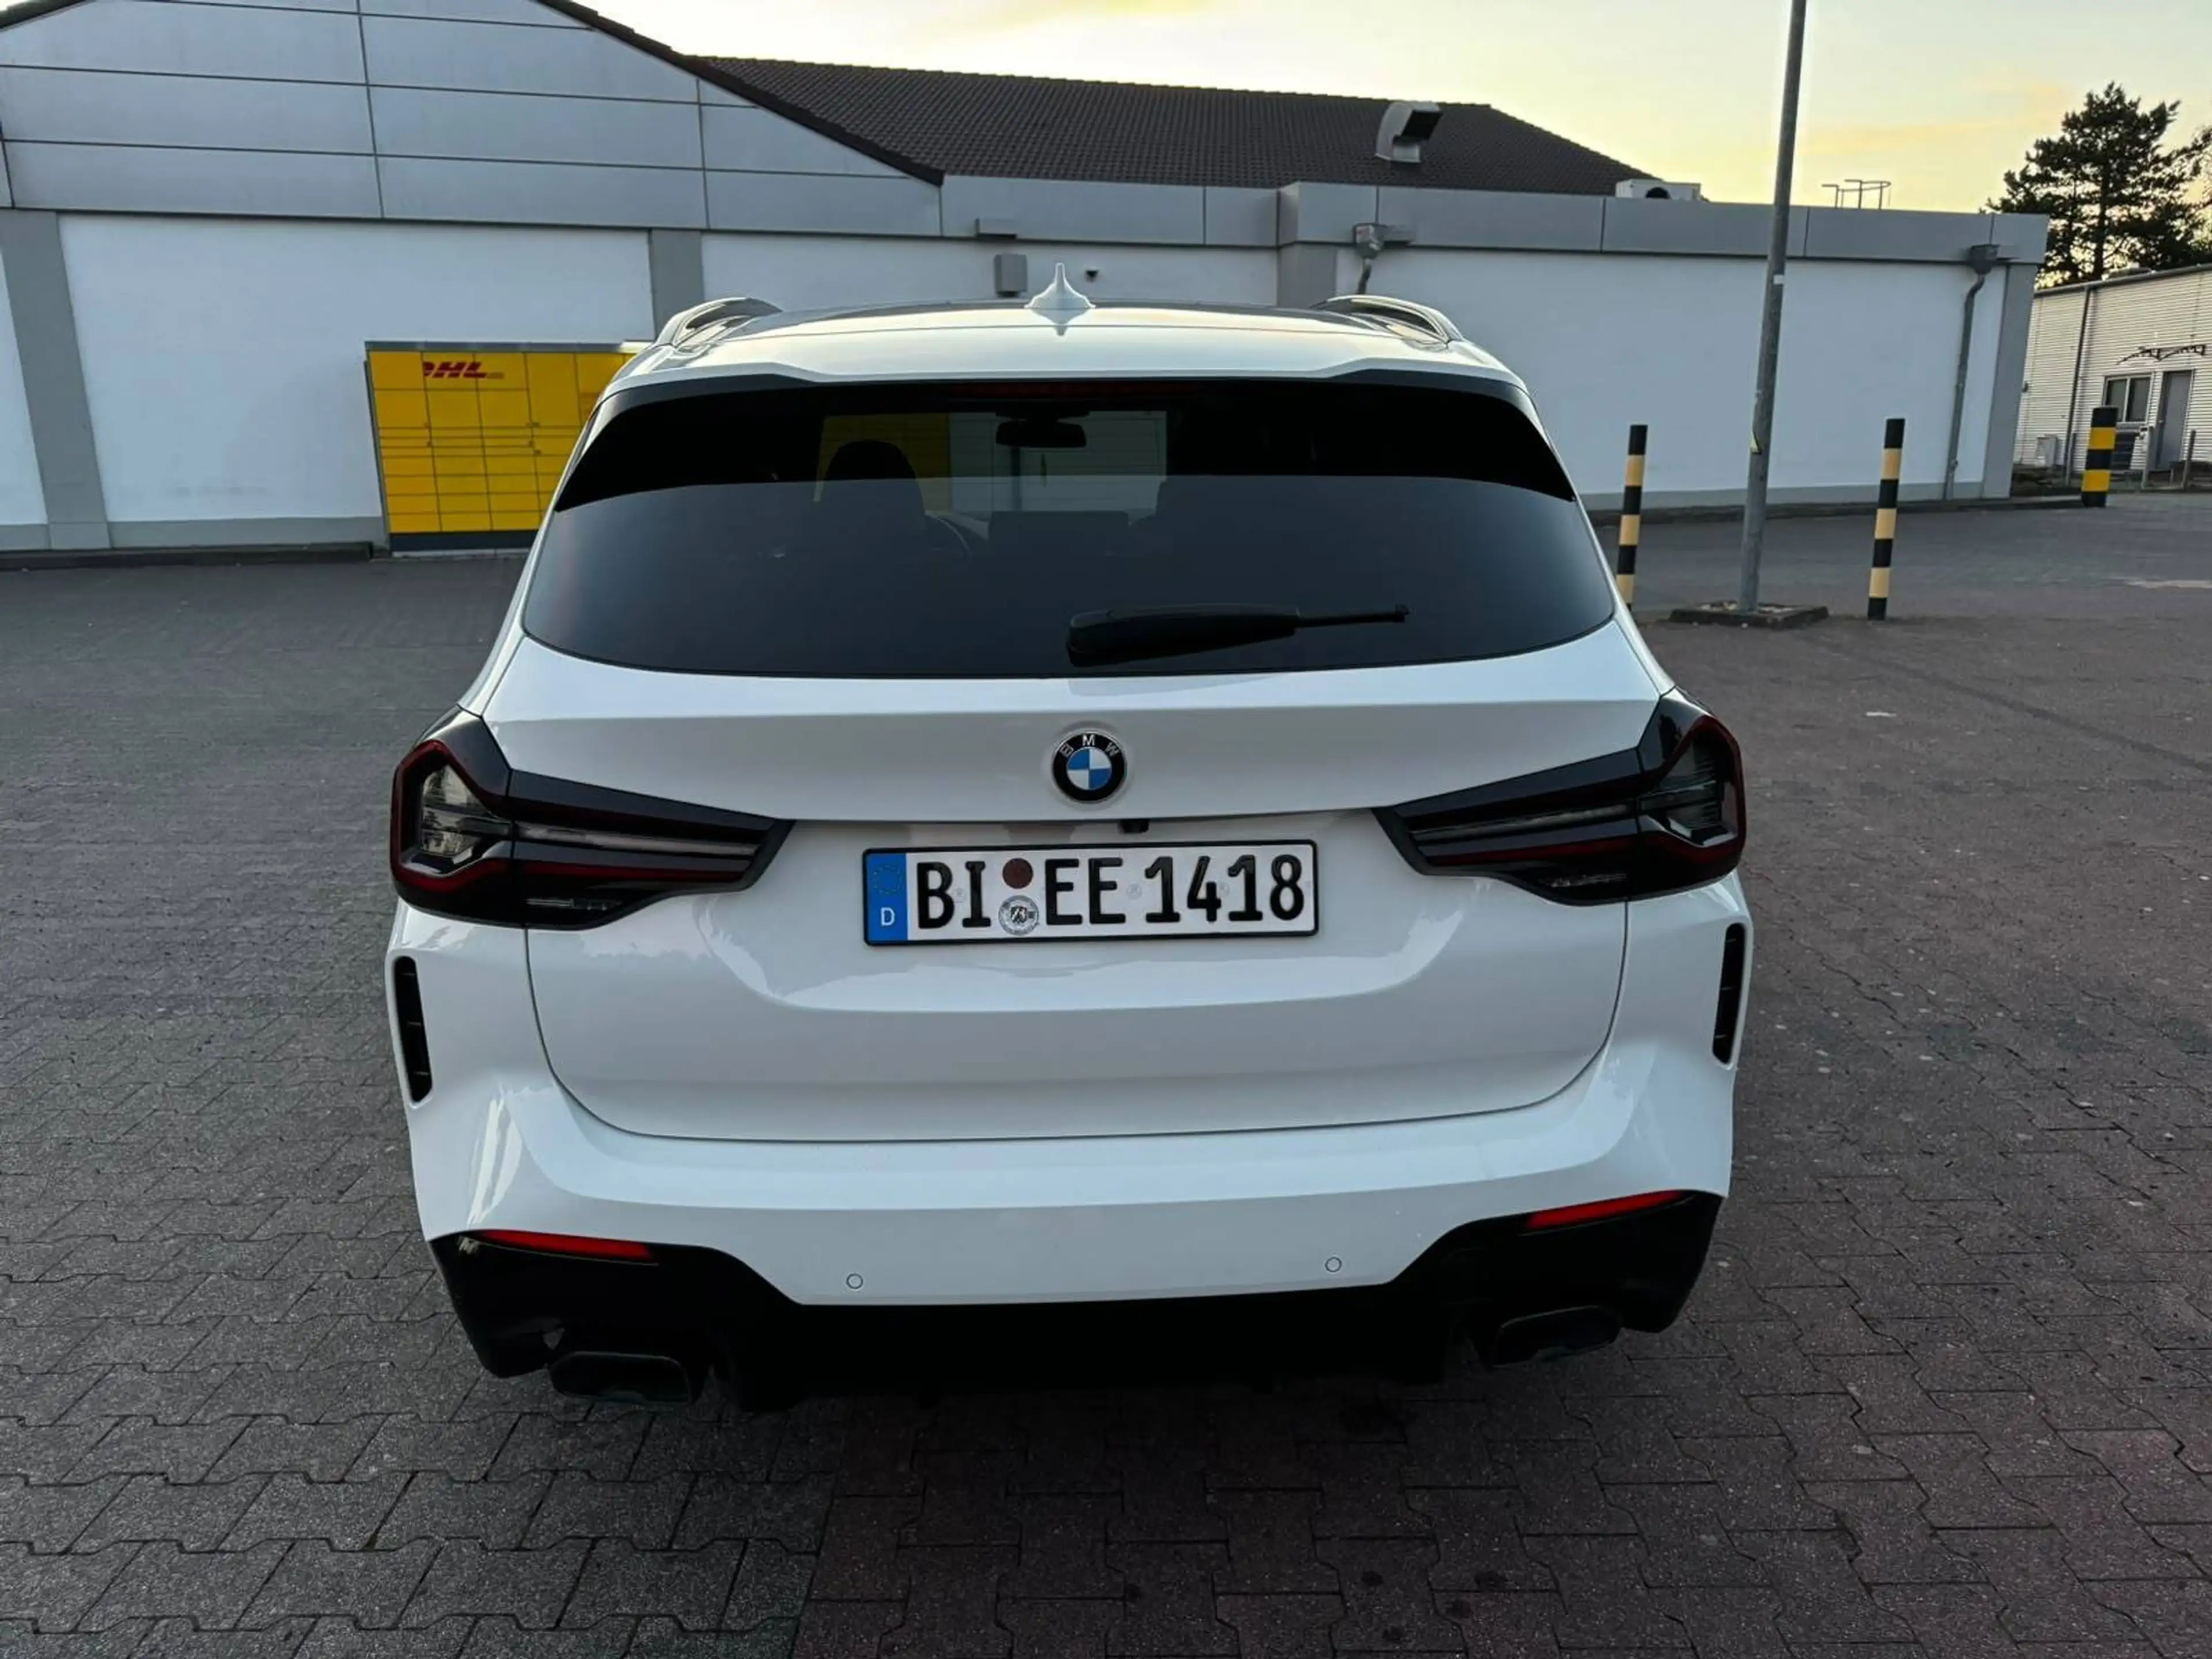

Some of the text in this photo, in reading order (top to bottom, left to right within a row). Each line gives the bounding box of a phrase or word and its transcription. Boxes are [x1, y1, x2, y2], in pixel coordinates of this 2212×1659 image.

[1059, 734, 1119, 757] BMW
[916, 861, 991, 929] BI
[1045, 857, 1126, 925] EE
[1145, 854, 1304, 923] 1418
[881, 907, 895, 926] D
